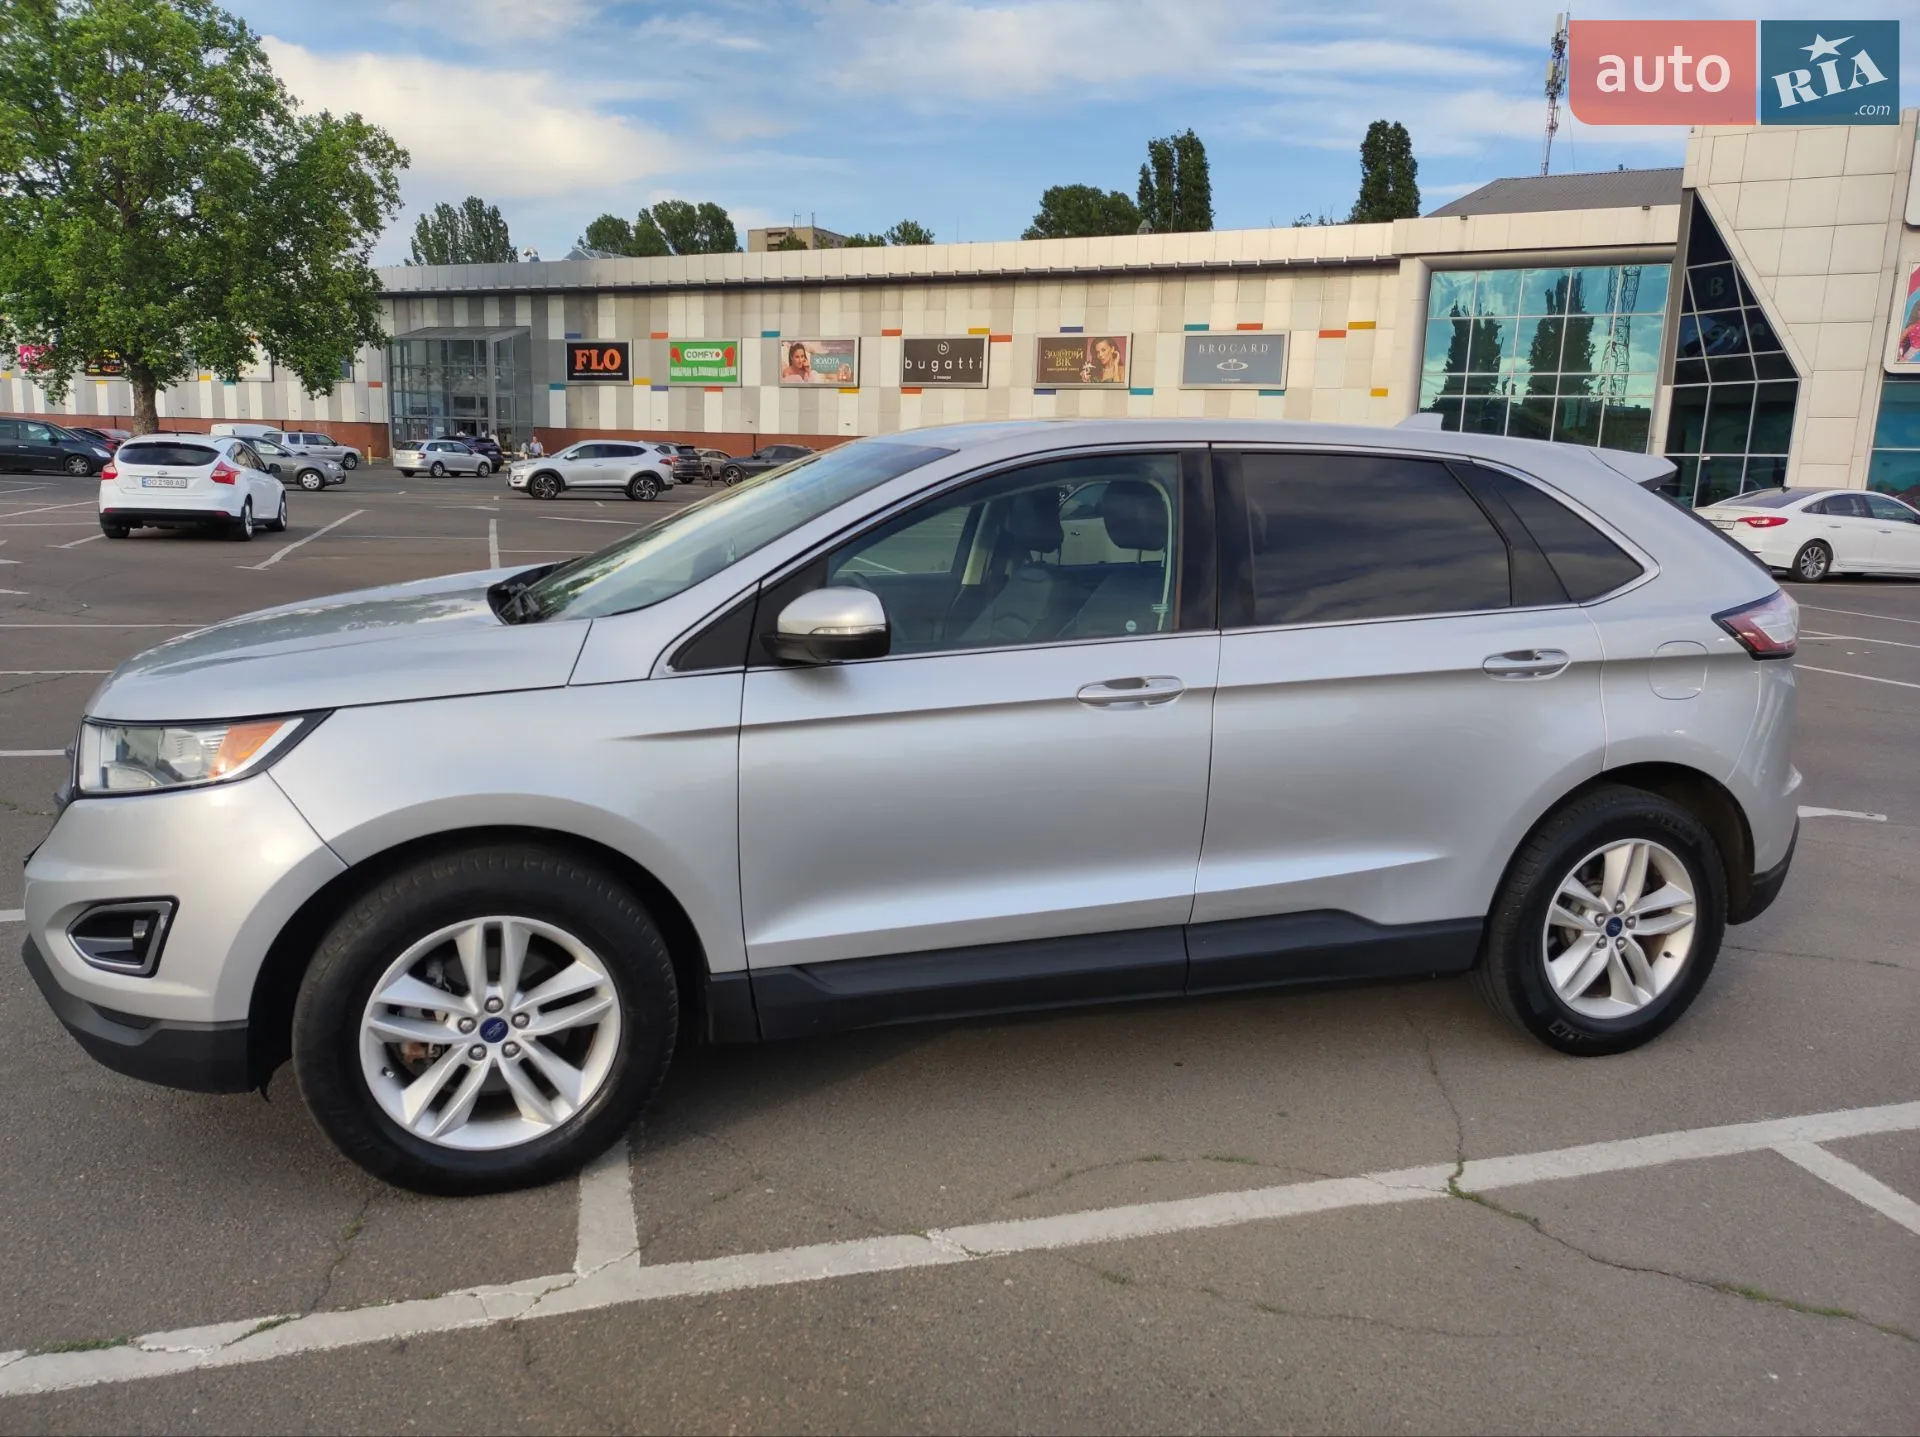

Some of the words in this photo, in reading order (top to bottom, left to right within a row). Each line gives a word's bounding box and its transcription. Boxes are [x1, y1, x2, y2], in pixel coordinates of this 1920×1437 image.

[686, 350, 714, 359] COMFY
[1199, 343, 1269, 353] BROCARD
[575, 348, 622, 370] FLO
[904, 356, 983, 373] bugatti
